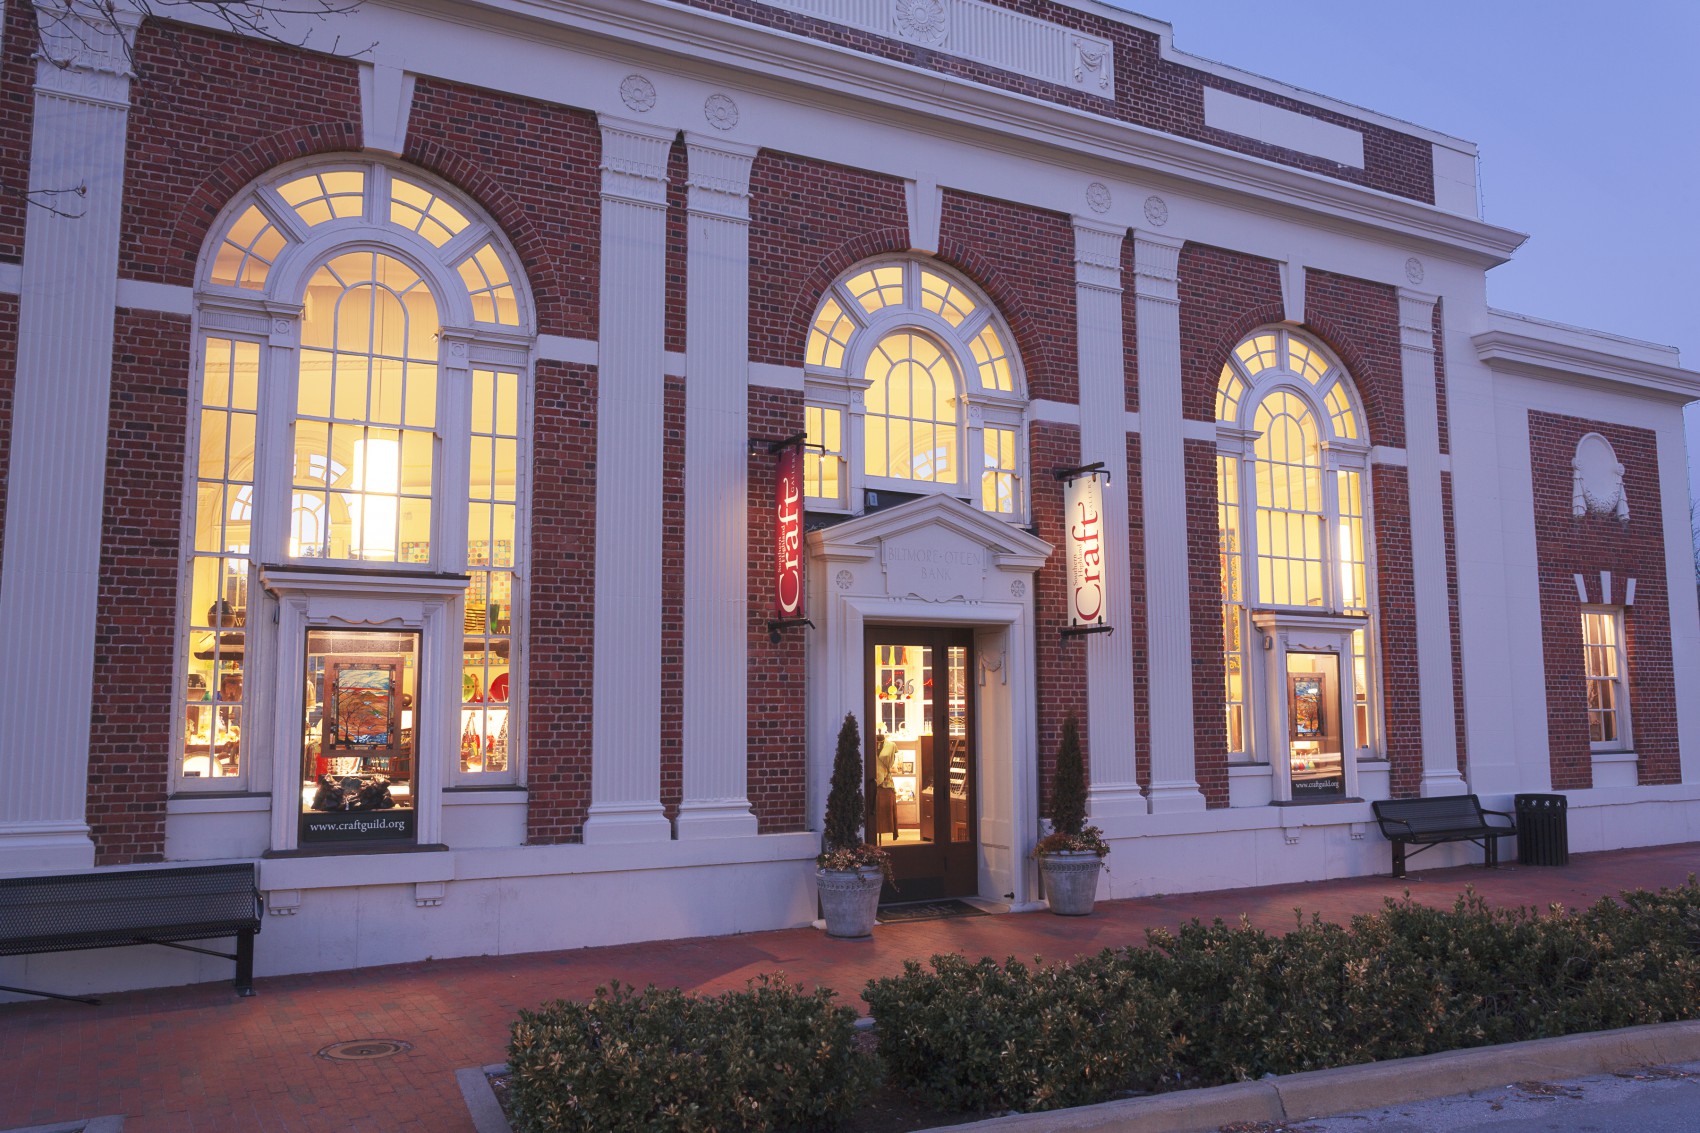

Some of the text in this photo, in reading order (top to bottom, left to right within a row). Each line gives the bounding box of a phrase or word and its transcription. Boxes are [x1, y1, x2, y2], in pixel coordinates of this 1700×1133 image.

[777, 477, 800, 613] Craft
[921, 566, 952, 581] BANK
[1072, 501, 1102, 621] Craft
[309, 818, 405, 833] www.craftguild.org
